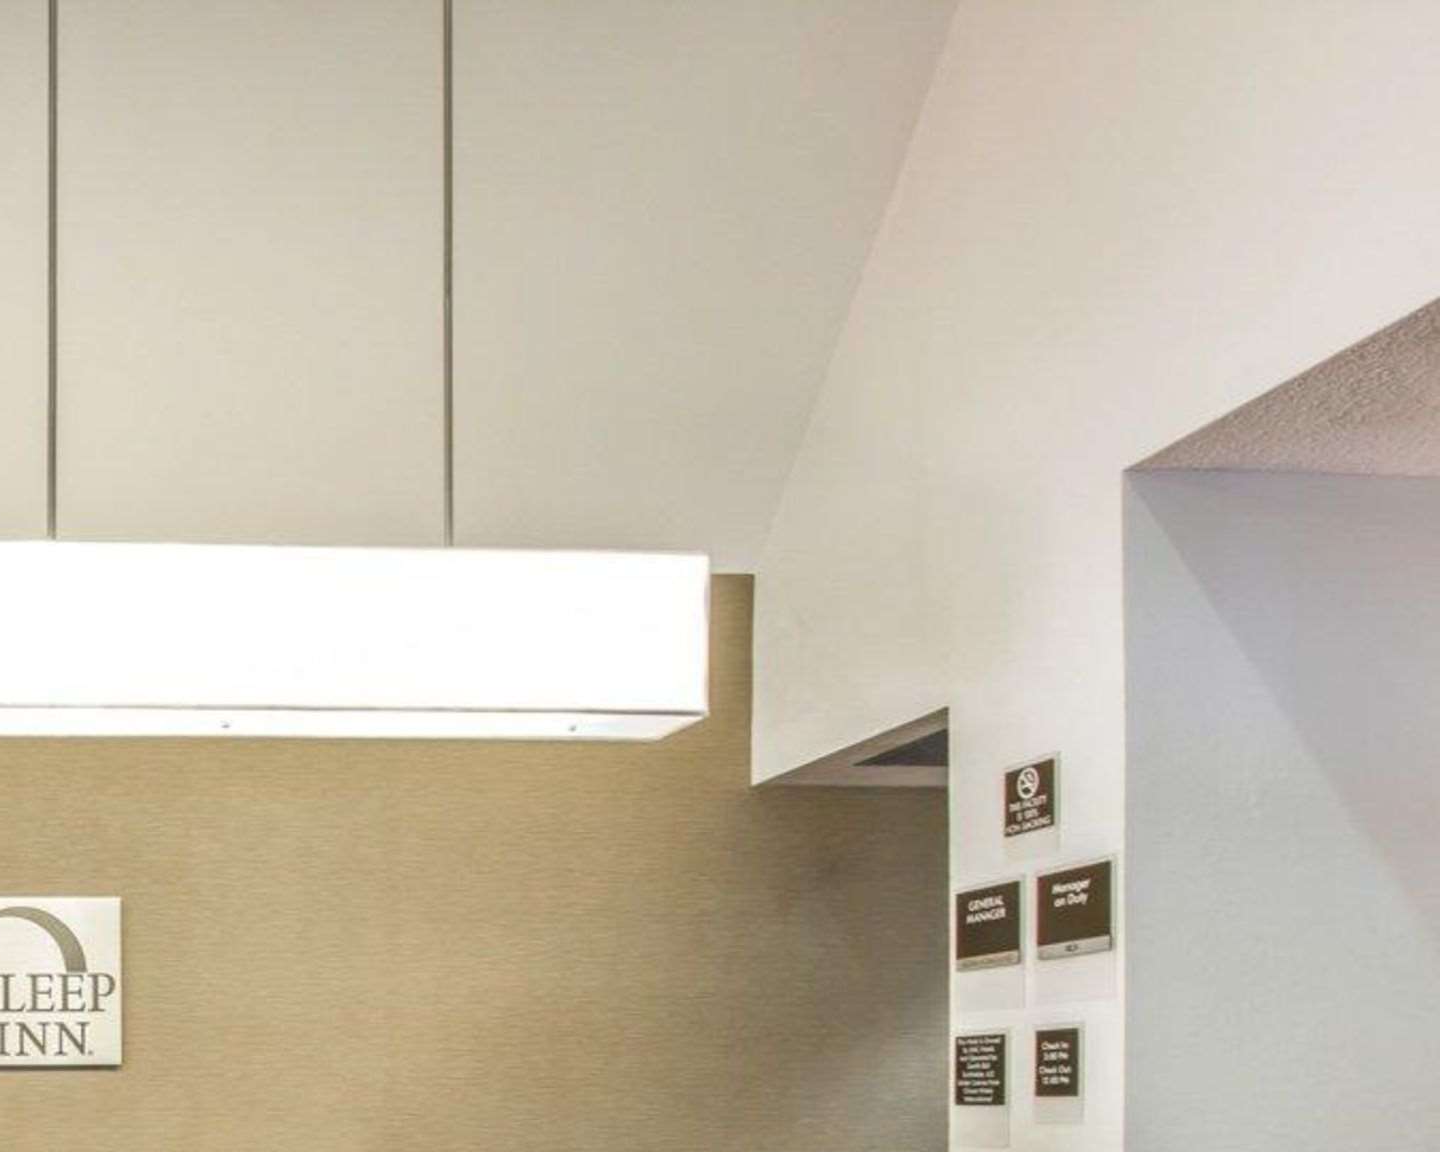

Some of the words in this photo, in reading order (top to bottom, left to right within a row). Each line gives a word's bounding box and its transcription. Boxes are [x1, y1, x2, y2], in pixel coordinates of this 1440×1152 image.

[1052, 878, 1091, 895] Manager
[968, 895, 1005, 912] GENERAL
[1067, 892, 1088, 905] Duty
[966, 907, 1006, 924] MANAGER
